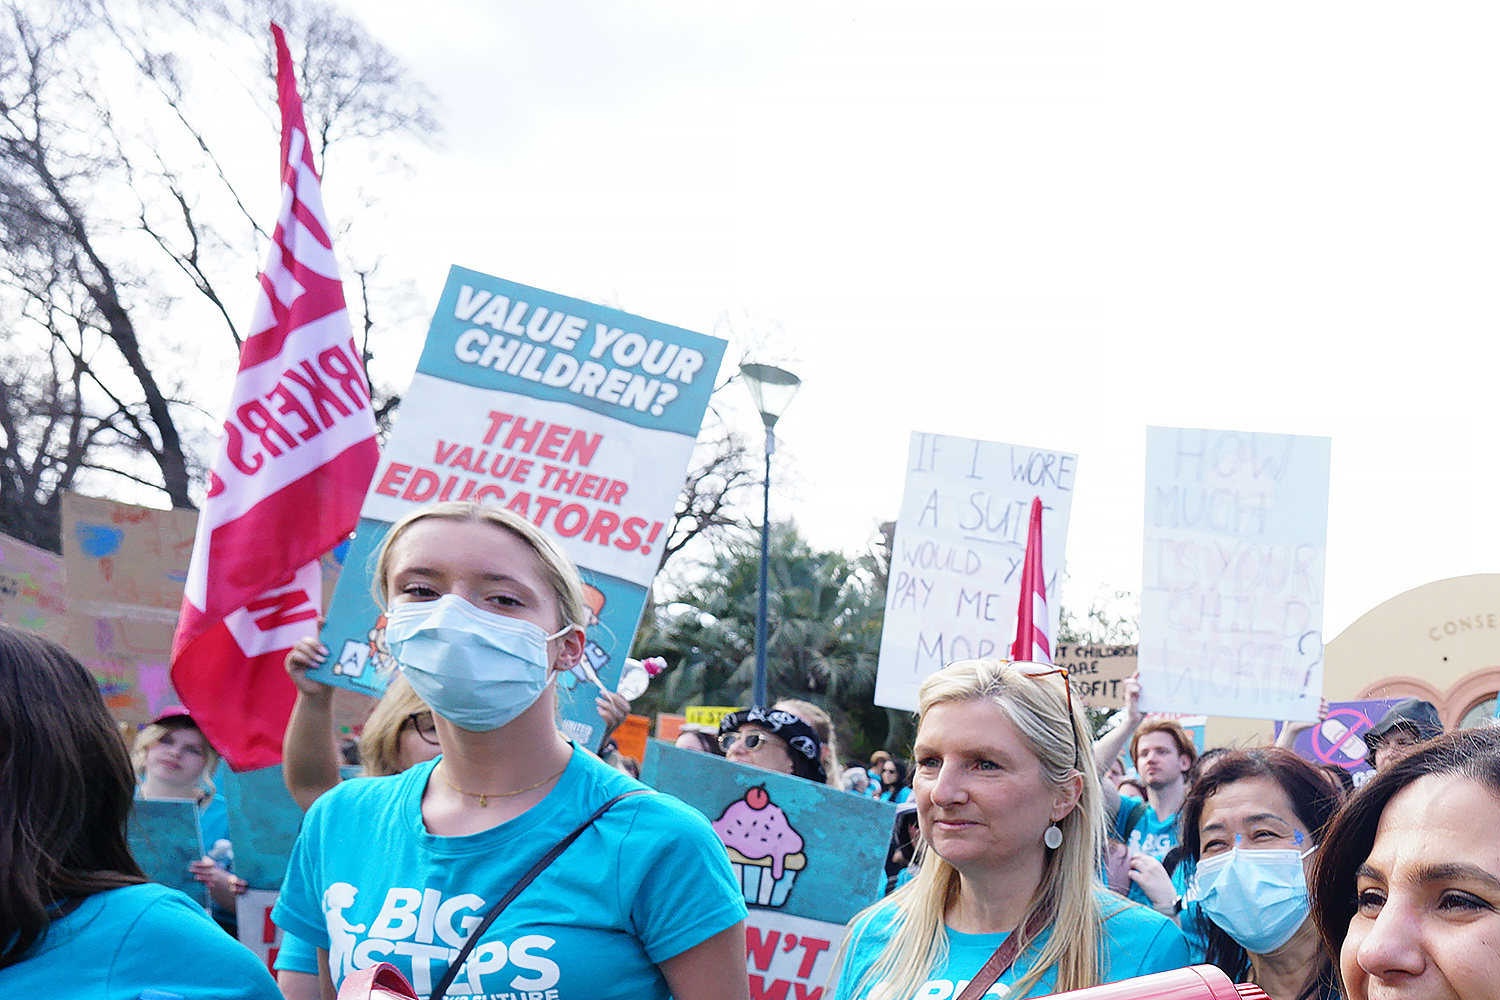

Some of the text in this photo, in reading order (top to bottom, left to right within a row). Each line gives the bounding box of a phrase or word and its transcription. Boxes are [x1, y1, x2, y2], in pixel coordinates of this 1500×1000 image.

[453, 284, 705, 385] VALUE YOUR
[454, 327, 680, 418] CHILDREN?
[482, 410, 604, 468] THEN
[913, 431, 1075, 492] IF I WORE
[1174, 428, 1296, 484] HOW
[432, 439, 629, 506] VALUE THEIR
[918, 488, 1054, 546] A SUI
[1154, 484, 1266, 535] MUCH
[901, 539, 982, 576] WOULD
[1210, 540, 1321, 606] YOUR
[891, 571, 1000, 622] PAY ME
[1164, 592, 1312, 640] CHILD
[914, 632, 1012, 676] MOR
[366, 886, 487, 950] BIG
[745, 925, 831, 980] N'T
